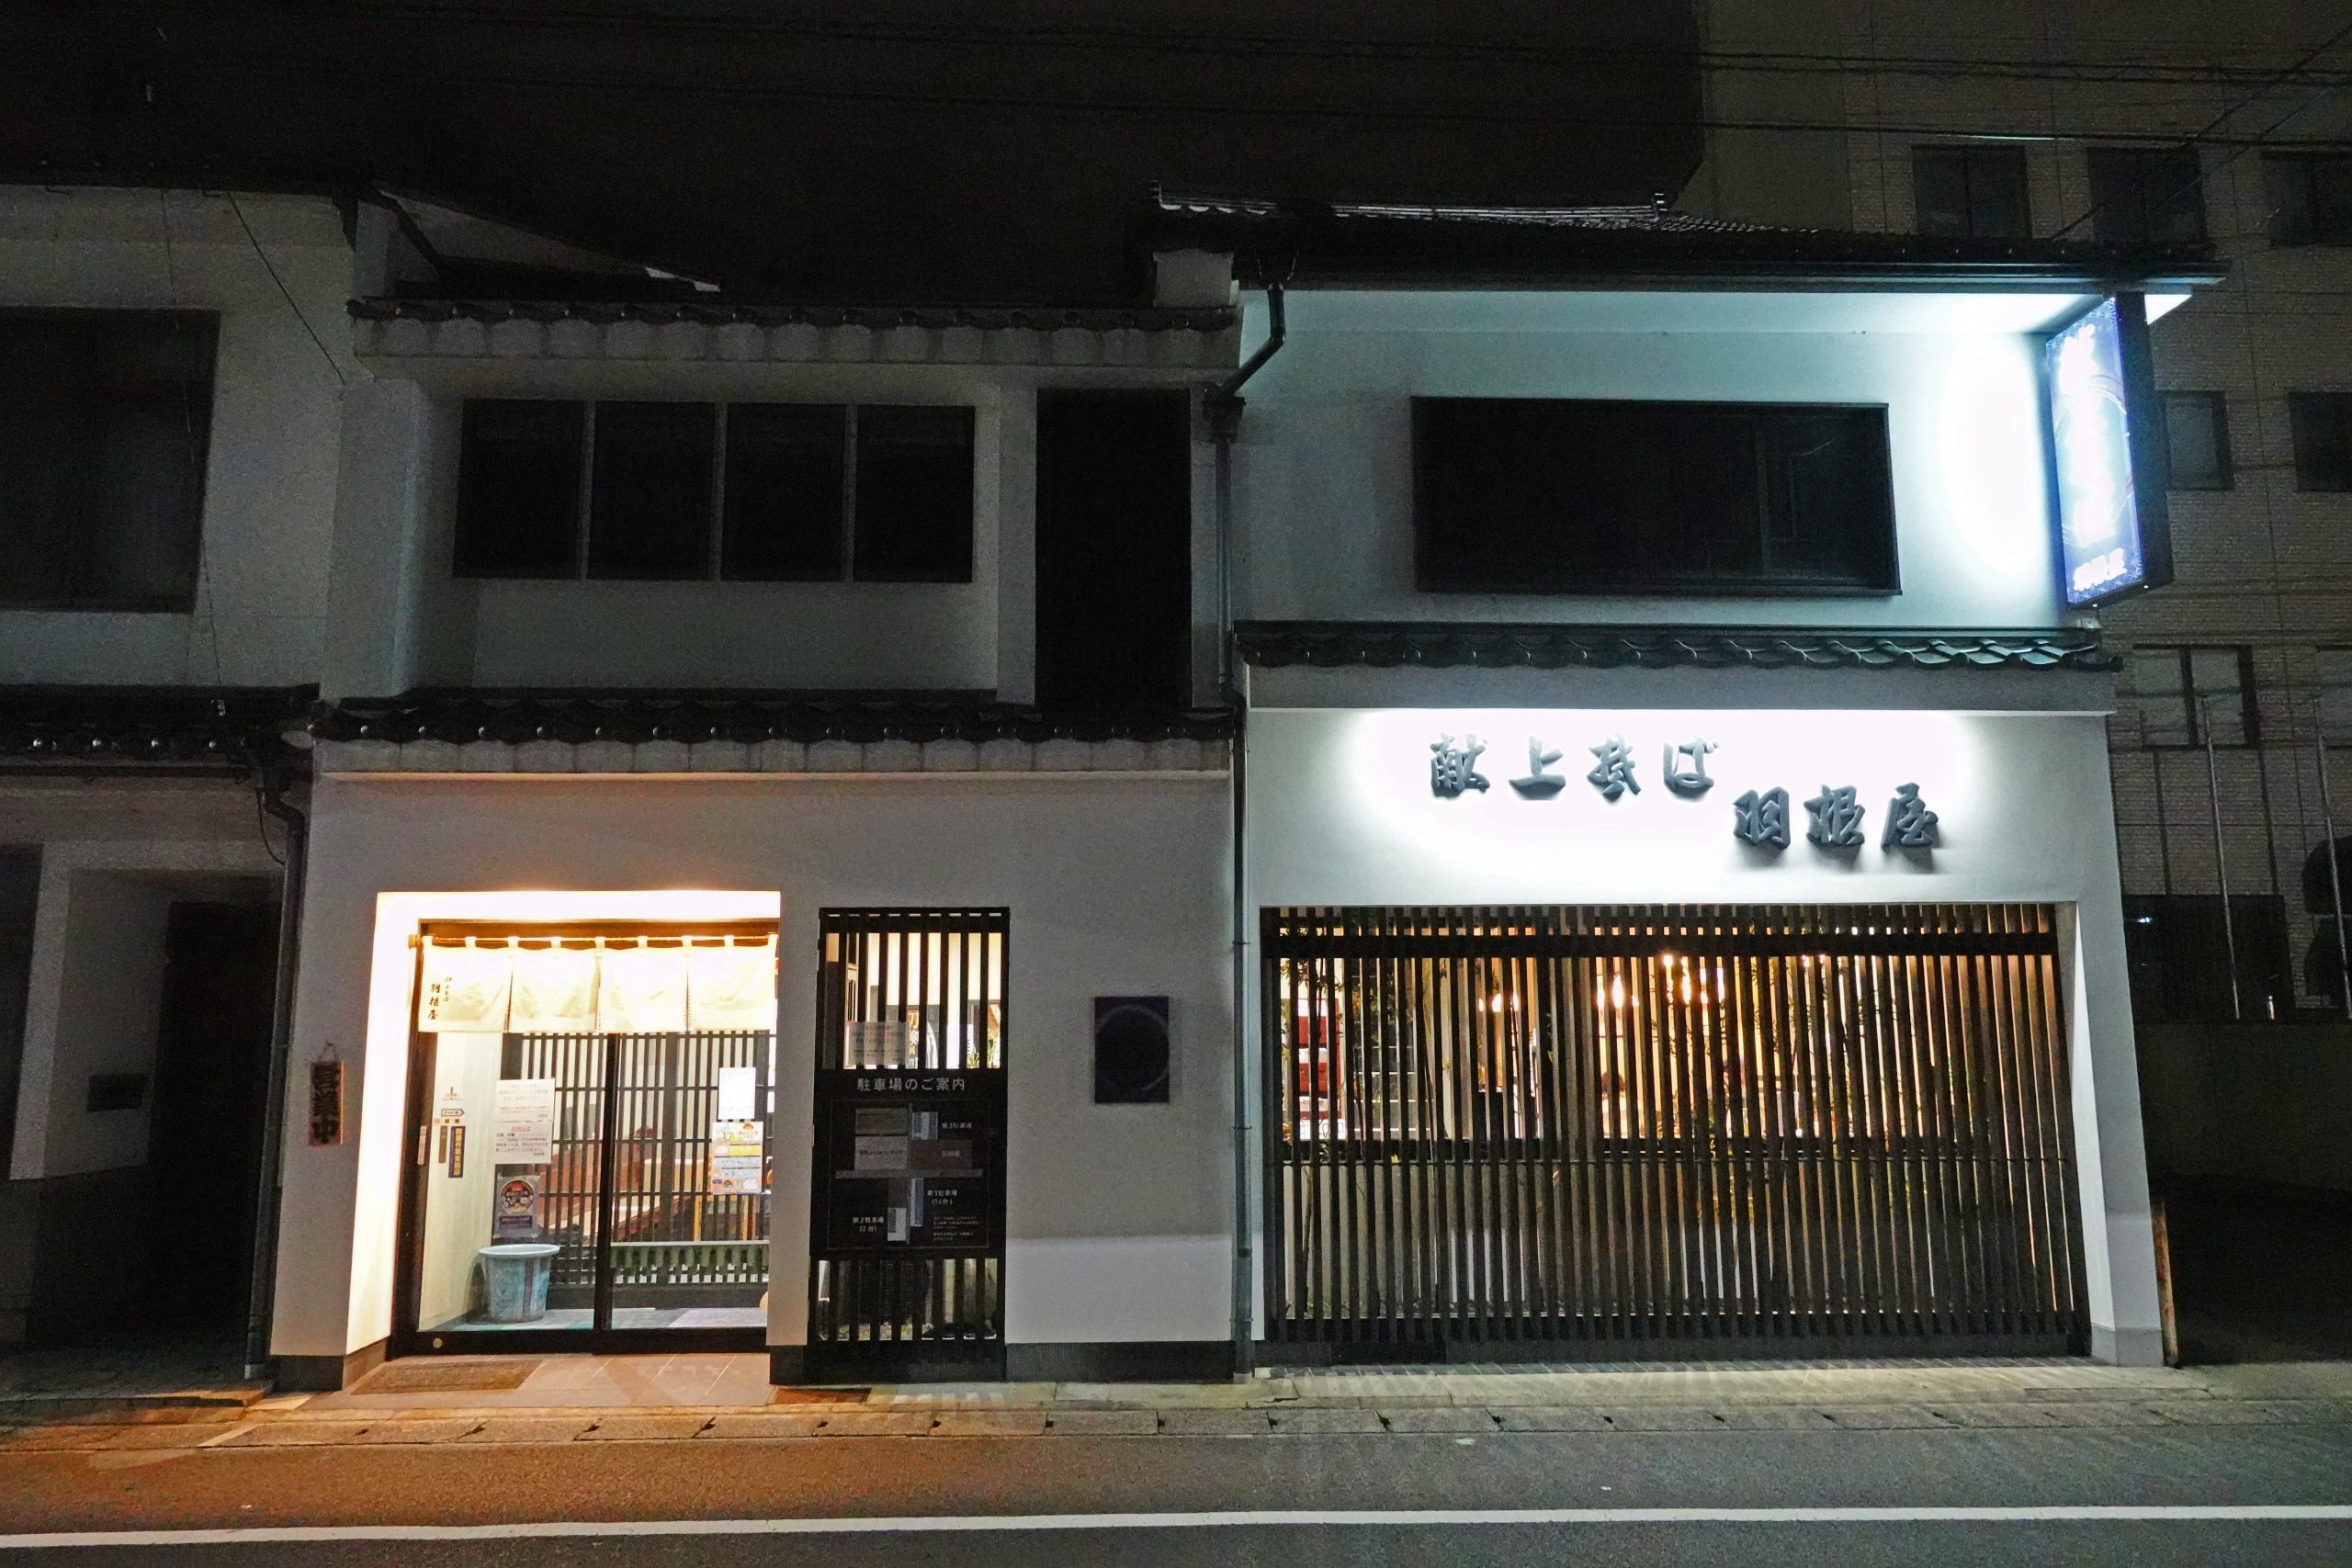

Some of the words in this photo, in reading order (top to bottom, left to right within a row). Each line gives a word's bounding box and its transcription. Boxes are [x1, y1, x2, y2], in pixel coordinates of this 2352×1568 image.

[1733, 782, 1940, 849] 羽根屋
[856, 1077, 966, 1092] 駐車場のご案内
